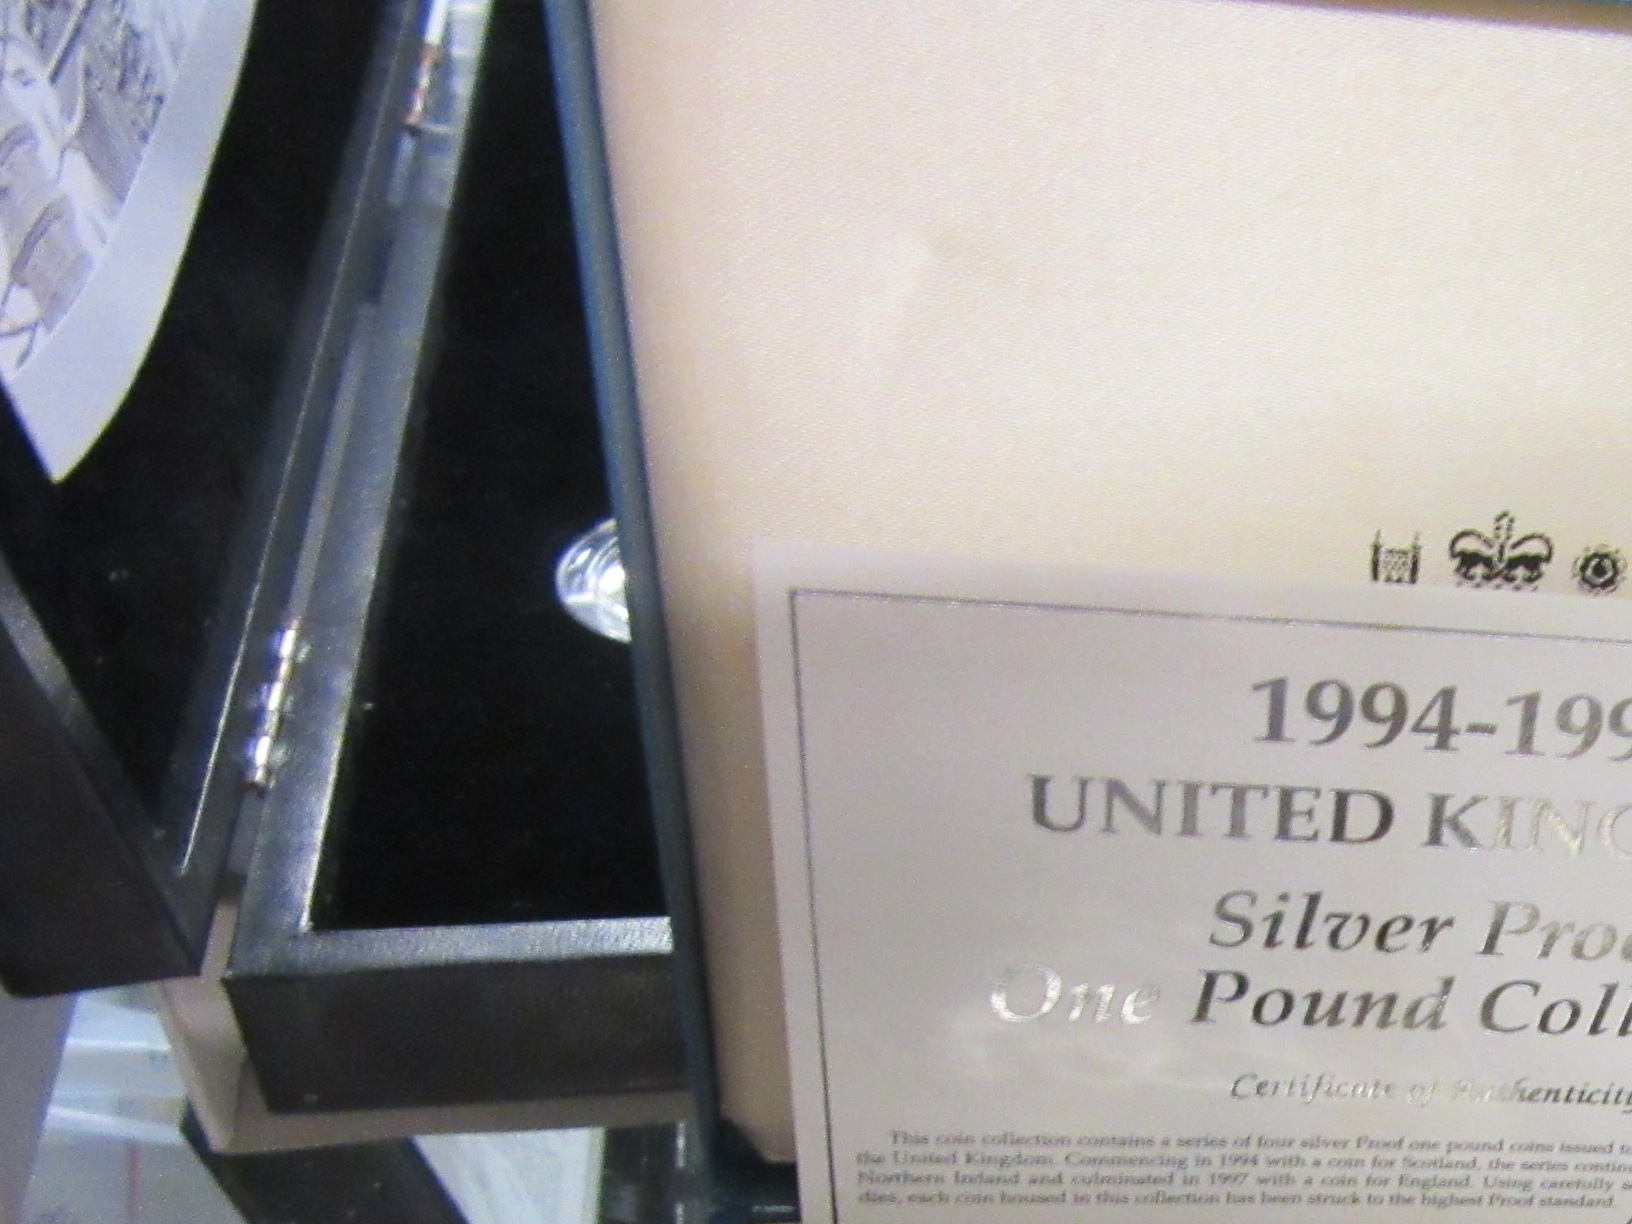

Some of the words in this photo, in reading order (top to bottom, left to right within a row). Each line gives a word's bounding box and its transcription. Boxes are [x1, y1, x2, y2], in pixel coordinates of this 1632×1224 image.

[1026, 774, 1396, 847] UNITED
[1209, 890, 1454, 956] Silver
[990, 963, 1161, 1026] One
[1190, 968, 1455, 1033] Pound
[1230, 1072, 1396, 1103] Certificate
[1407, 1076, 1439, 1105] of
